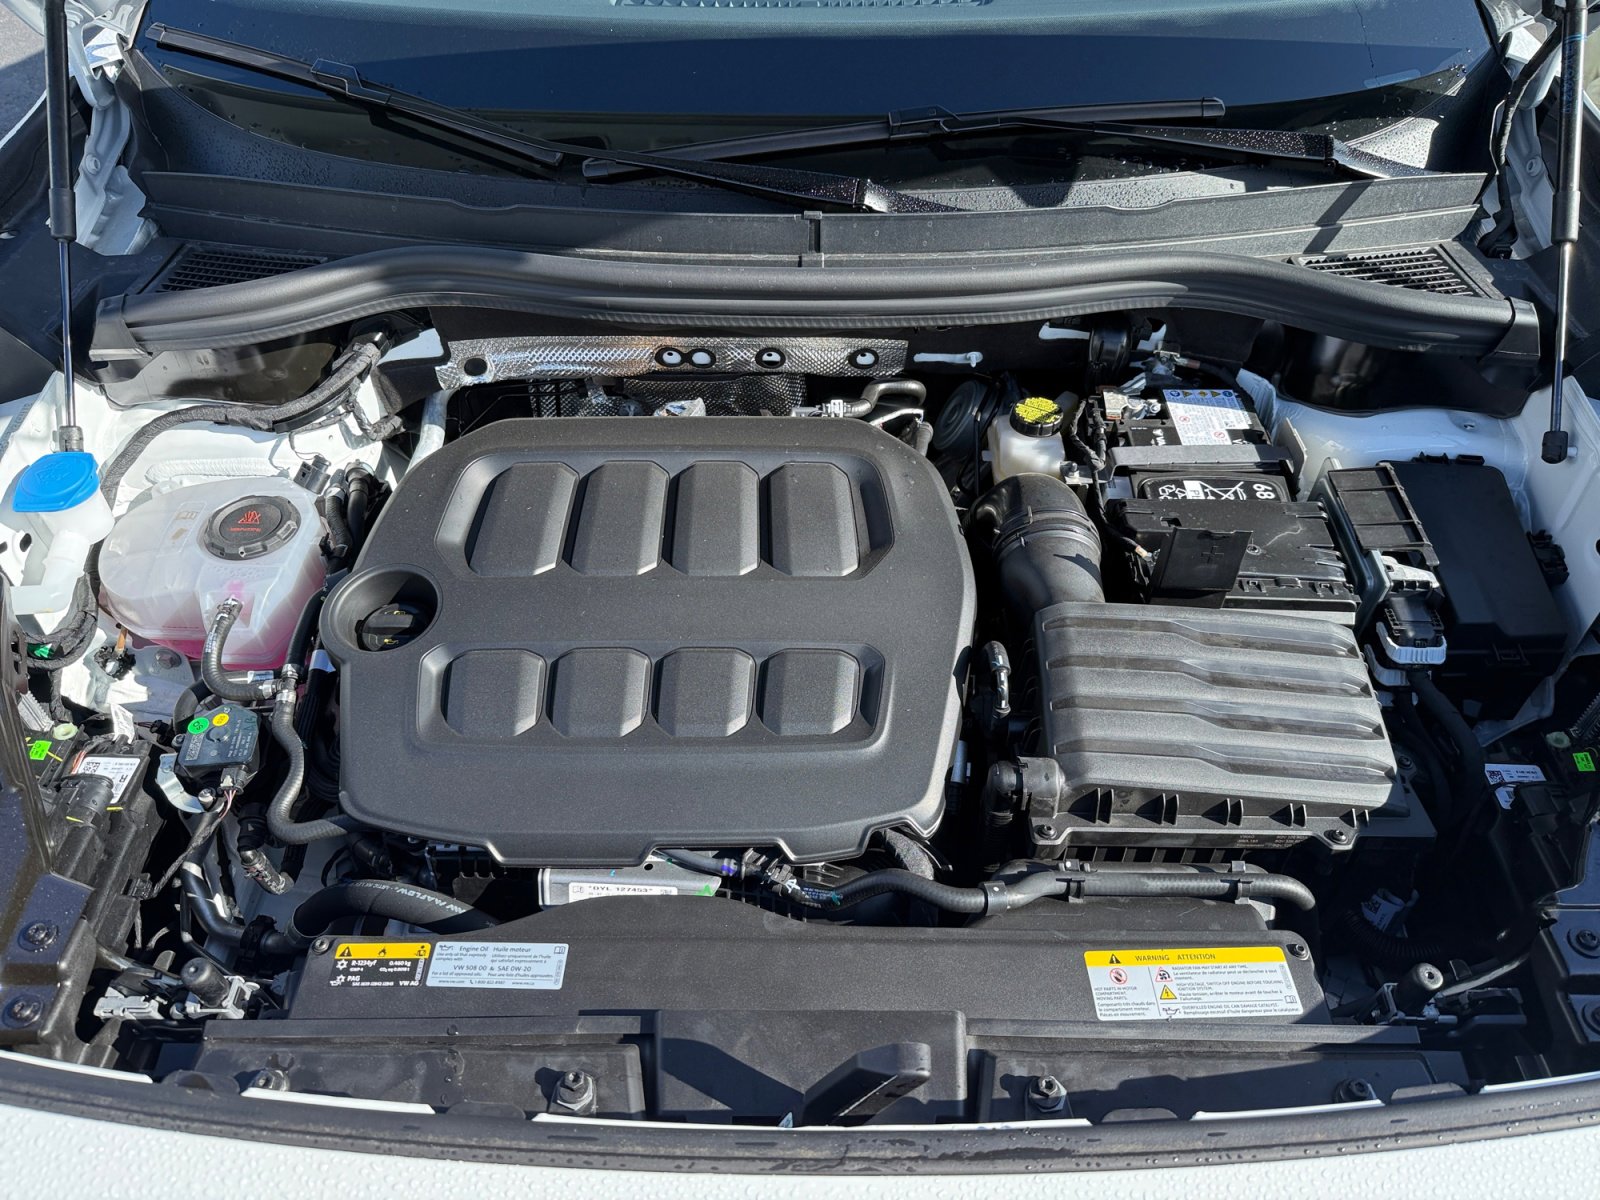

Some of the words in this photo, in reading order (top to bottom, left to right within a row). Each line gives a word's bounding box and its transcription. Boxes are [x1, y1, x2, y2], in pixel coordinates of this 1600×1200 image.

[1252, 483, 1275, 499] 68
[1135, 954, 1170, 962] WARNING
[1177, 952, 1216, 961] ATTENTION
[351, 959, 378, 968] R-1234yf
[405, 960, 411, 968] kg
